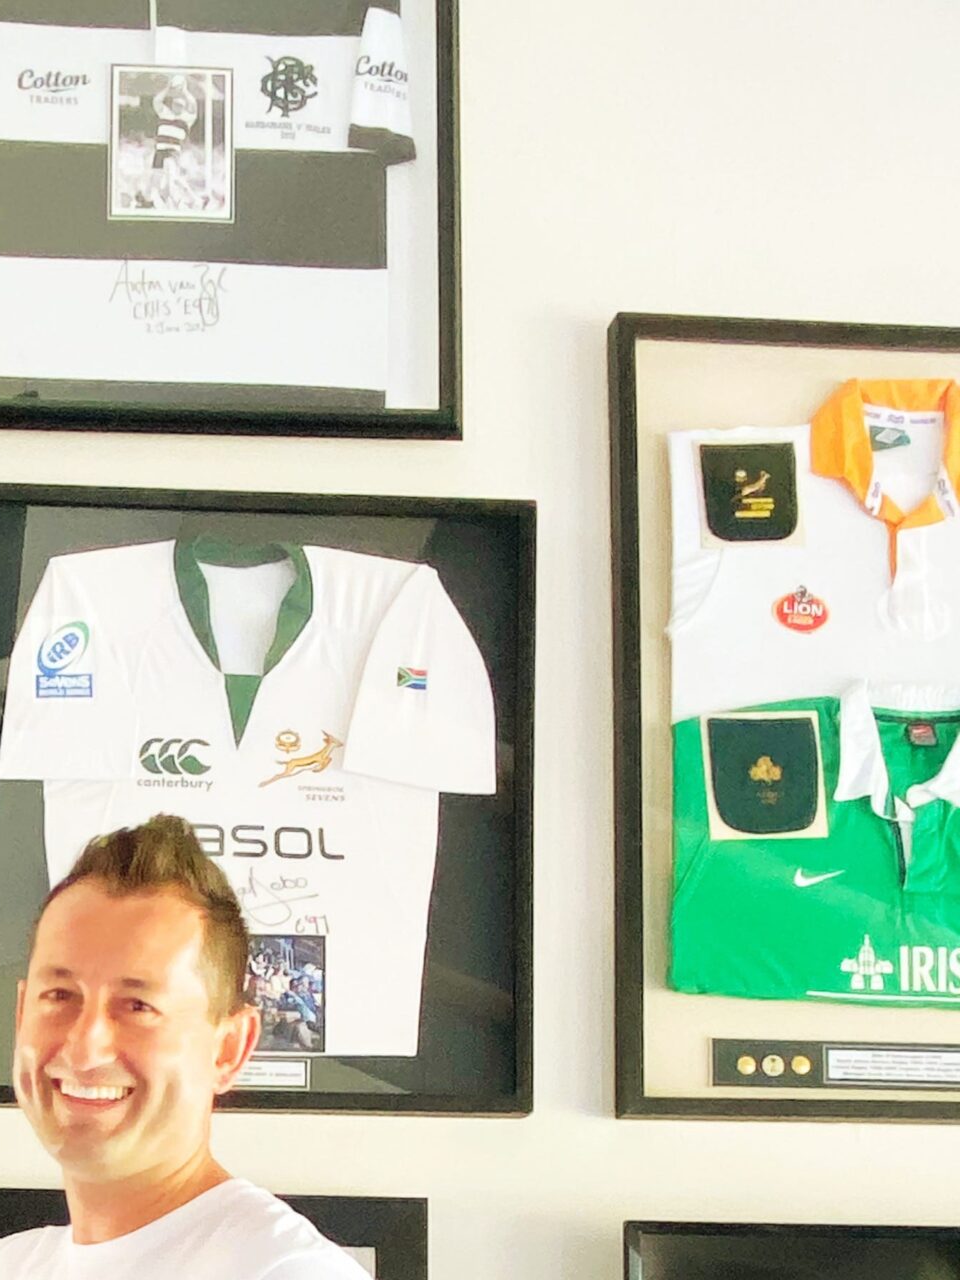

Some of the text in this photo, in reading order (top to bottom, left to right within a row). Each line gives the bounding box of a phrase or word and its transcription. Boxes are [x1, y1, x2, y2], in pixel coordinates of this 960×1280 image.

[17, 69, 90, 91] Cotton
[30, 96, 79, 106] TRADERS
[783, 600, 824, 618] LION
[137, 776, 213, 793] canterbury
